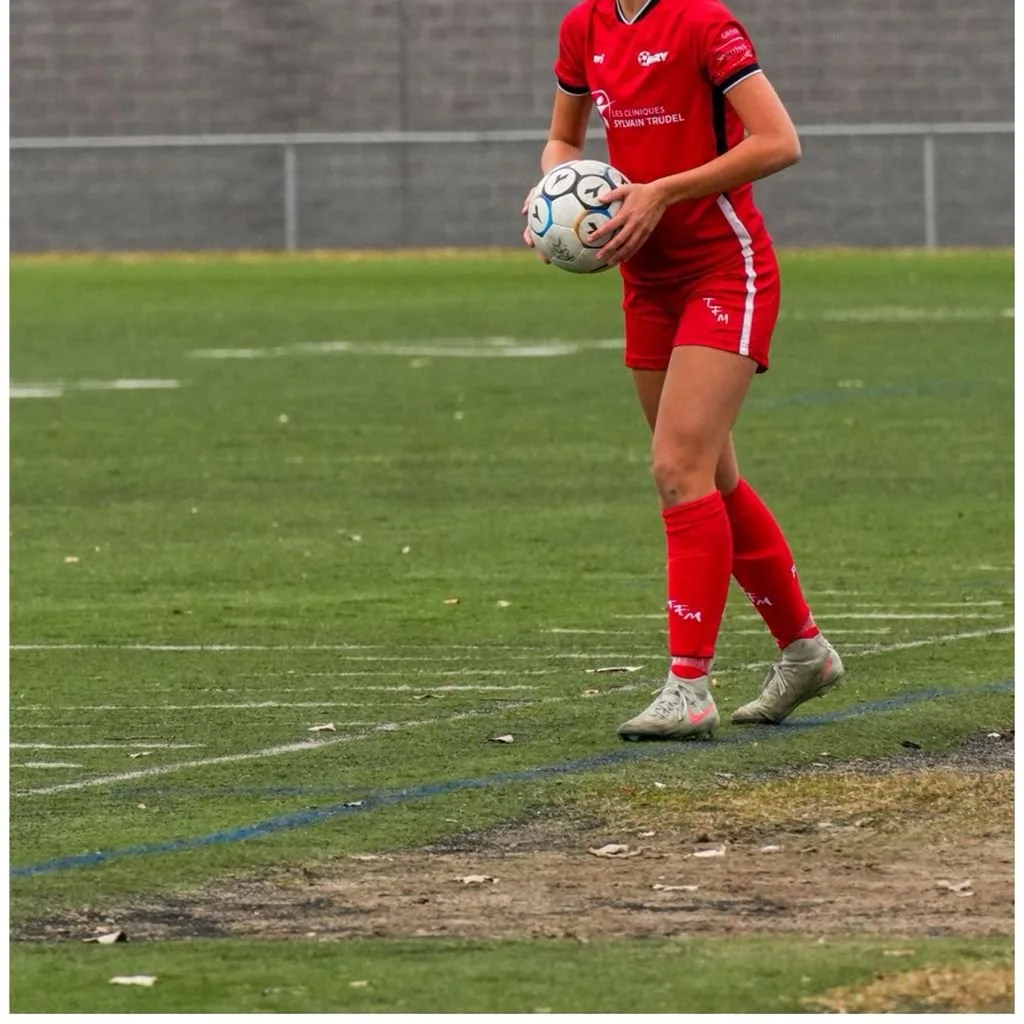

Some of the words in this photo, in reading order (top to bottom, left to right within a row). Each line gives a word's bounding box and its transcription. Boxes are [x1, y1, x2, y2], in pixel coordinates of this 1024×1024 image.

[611, 109, 624, 118] LES
[623, 105, 666, 118] CLINIQUES
[613, 117, 645, 128] SYLVAIN
[646, 112, 686, 126] TRUDEL
